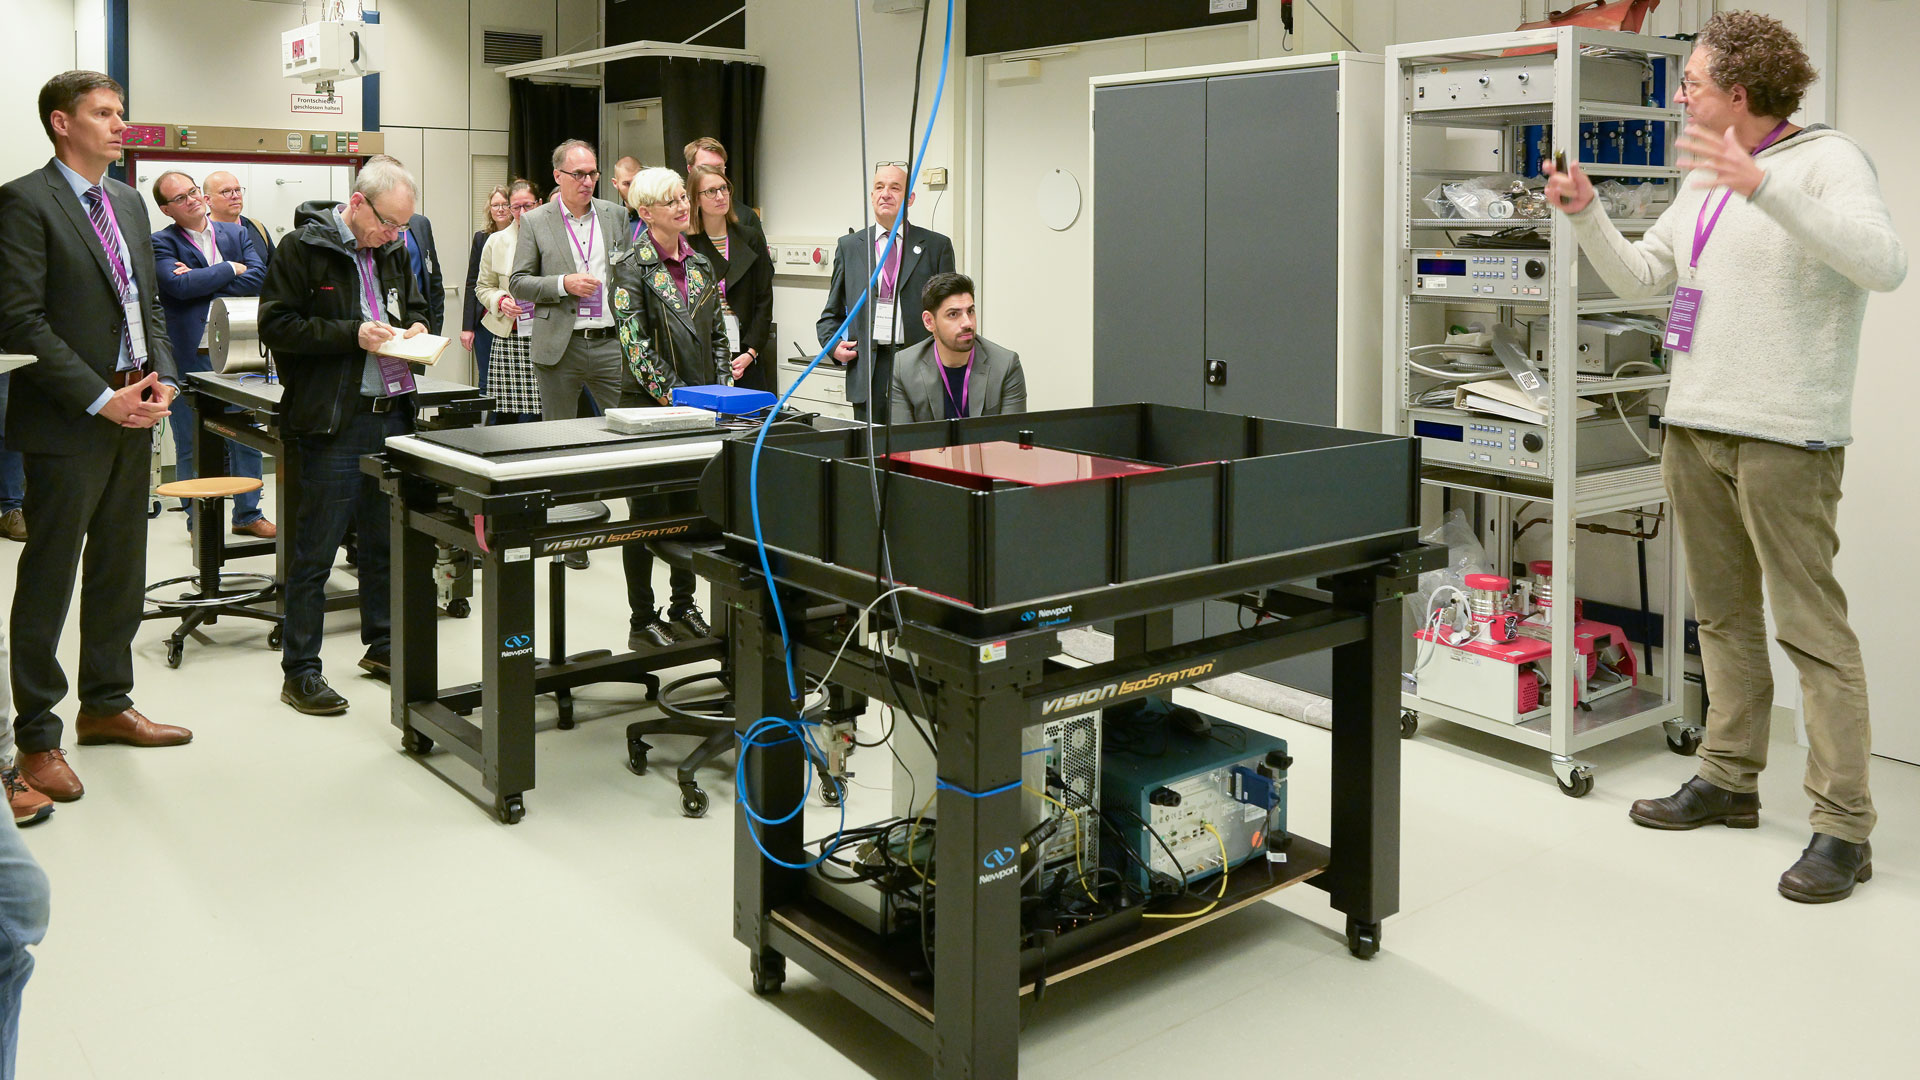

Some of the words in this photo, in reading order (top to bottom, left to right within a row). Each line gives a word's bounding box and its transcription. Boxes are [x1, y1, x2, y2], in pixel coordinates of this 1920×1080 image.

[543, 534, 606, 552] VISION
[1038, 604, 1072, 618] Newport
[501, 647, 533, 658] Newport
[1042, 683, 1117, 715] VISION
[979, 864, 1018, 885] Newport
